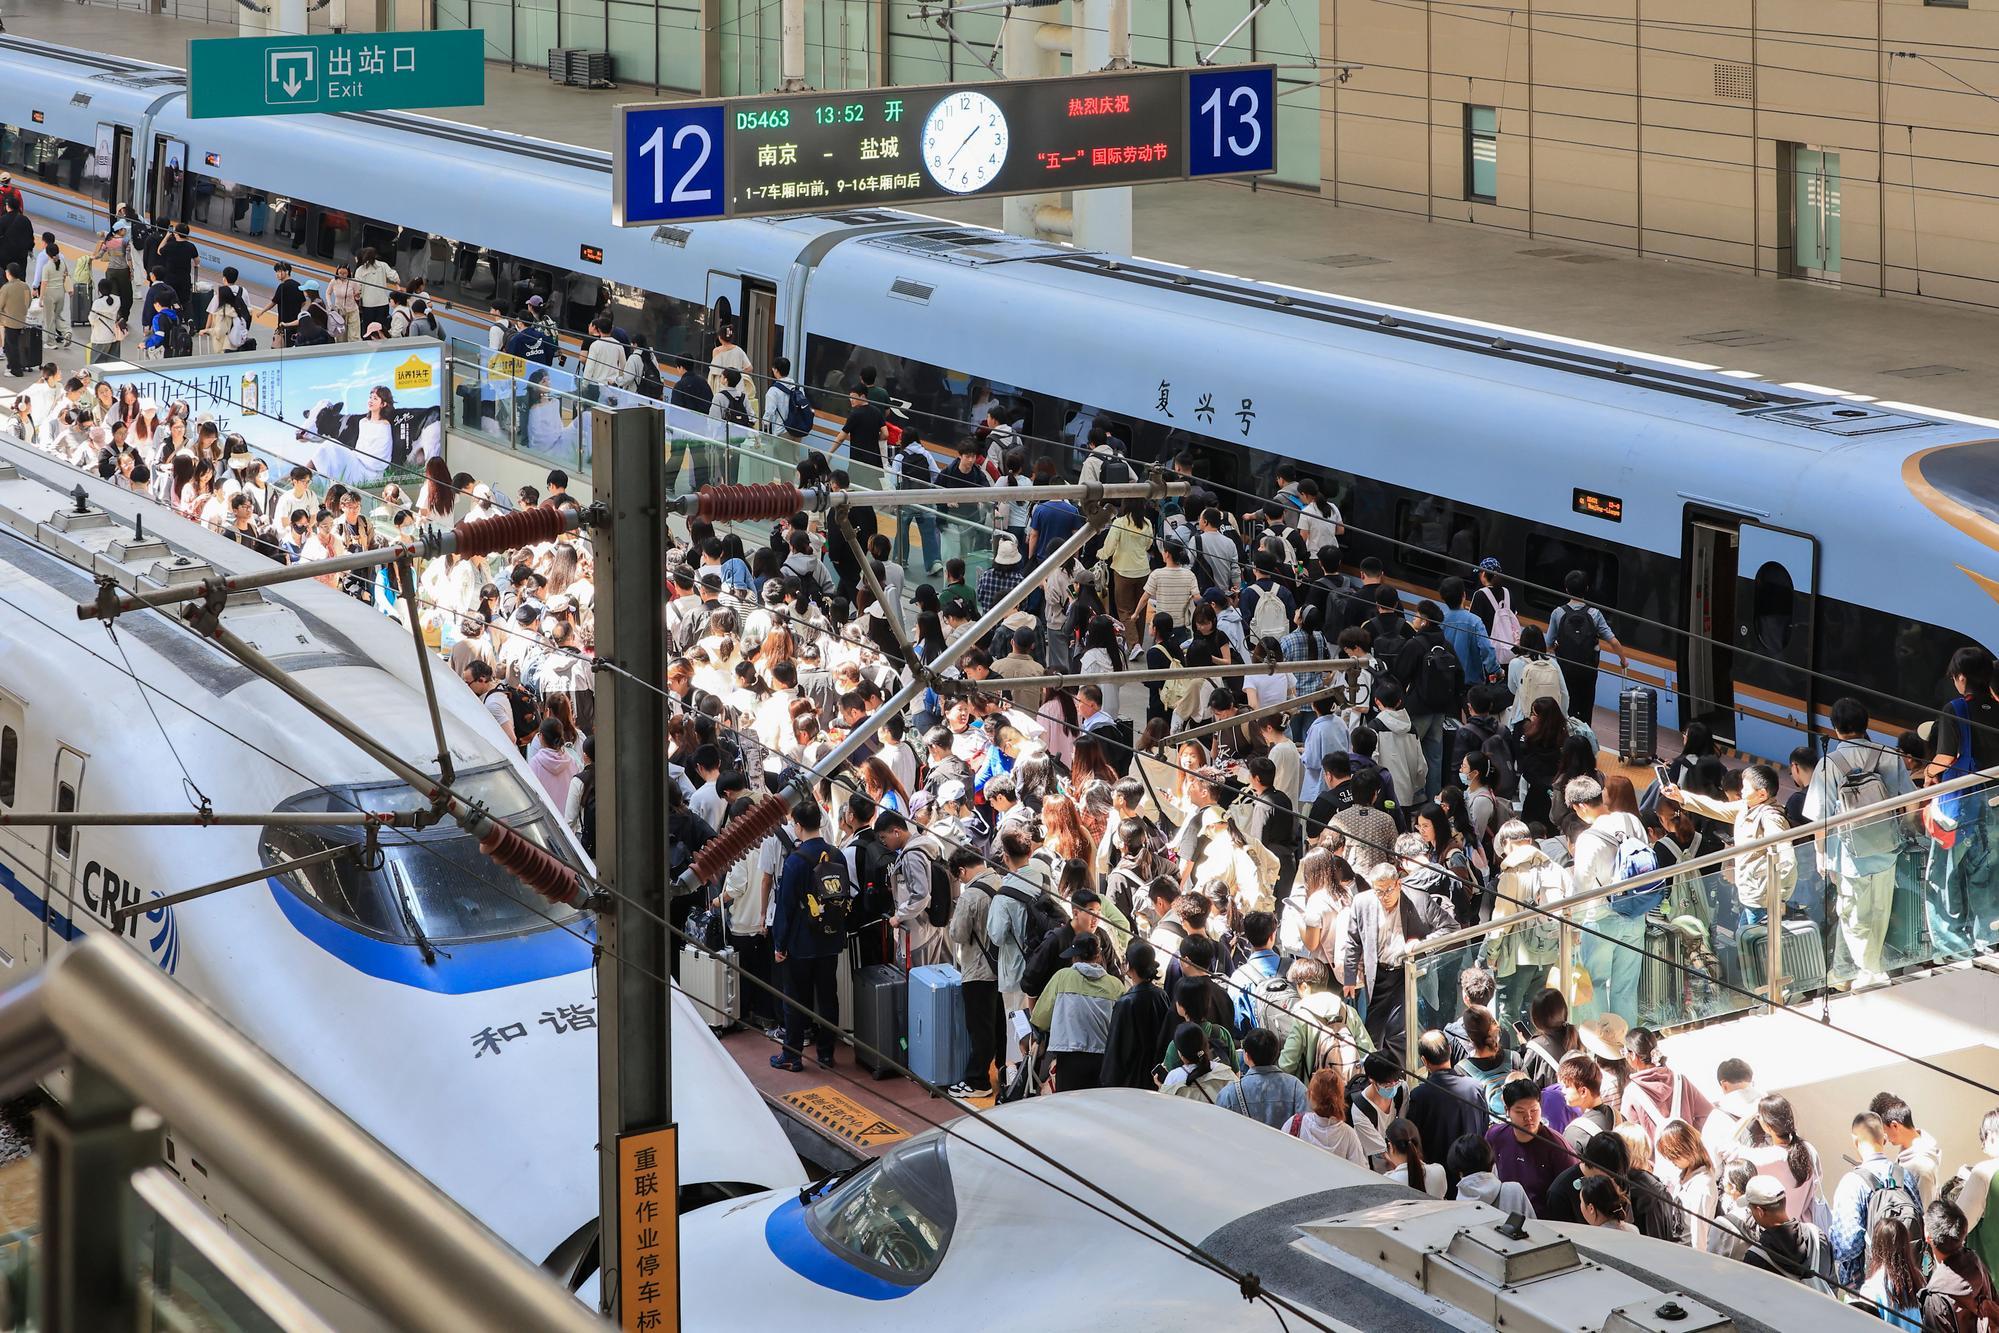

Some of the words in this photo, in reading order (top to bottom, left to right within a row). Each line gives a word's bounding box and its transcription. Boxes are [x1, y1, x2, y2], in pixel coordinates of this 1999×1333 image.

[328, 44, 416, 76] 出站口
[328, 80, 363, 98] Exit
[737, 110, 790, 130] D5463
[815, 104, 865, 125] 13:52
[884, 100, 904, 122] 开
[960, 98, 970, 110] 12
[1068, 95, 1131, 117] 热烈庆祝
[989, 114, 996, 127] 2
[1200, 86, 1262, 158] 13
[758, 142, 798, 167] 南京
[860, 135, 900, 160] 盐城
[994, 133, 1001, 146] 3
[639, 124, 712, 204] 12
[989, 153, 996, 165] 4
[961, 172, 969, 185] 6
[525, 348, 545, 357] adidas
[398, 369, 429, 380] 认养1头牛
[116, 375, 232, 412] 机好牛奶
[1155, 379, 1256, 436] 复兴号
[83, 861, 141, 939] CRH
[633, 1146, 662, 1333] 重联作业停车标
